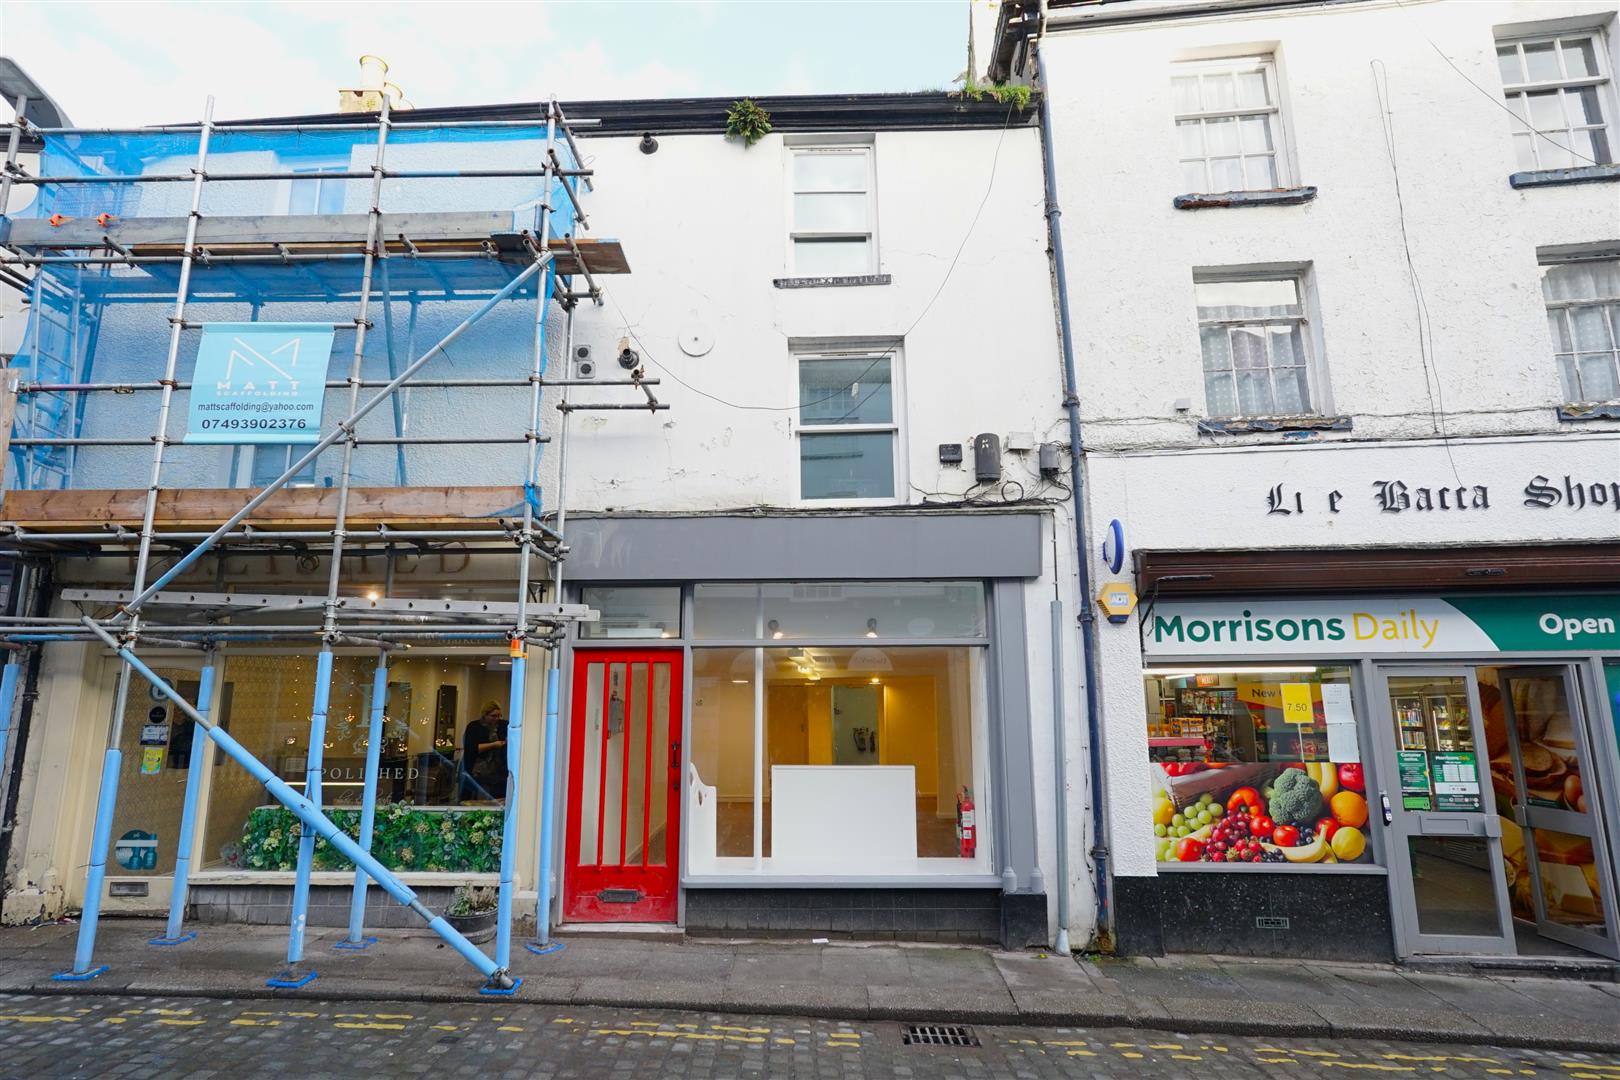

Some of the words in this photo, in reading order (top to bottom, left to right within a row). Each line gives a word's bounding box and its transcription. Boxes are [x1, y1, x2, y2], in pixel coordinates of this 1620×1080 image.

[198, 402, 314, 412] mattscaffolding@yahoo.com
[202, 419, 306, 429] 07493902376
[1155, 609, 1345, 643] Morrisons
[1352, 608, 1440, 650] Daily
[1539, 612, 1616, 641] Open
[1251, 688, 1276, 698] New
